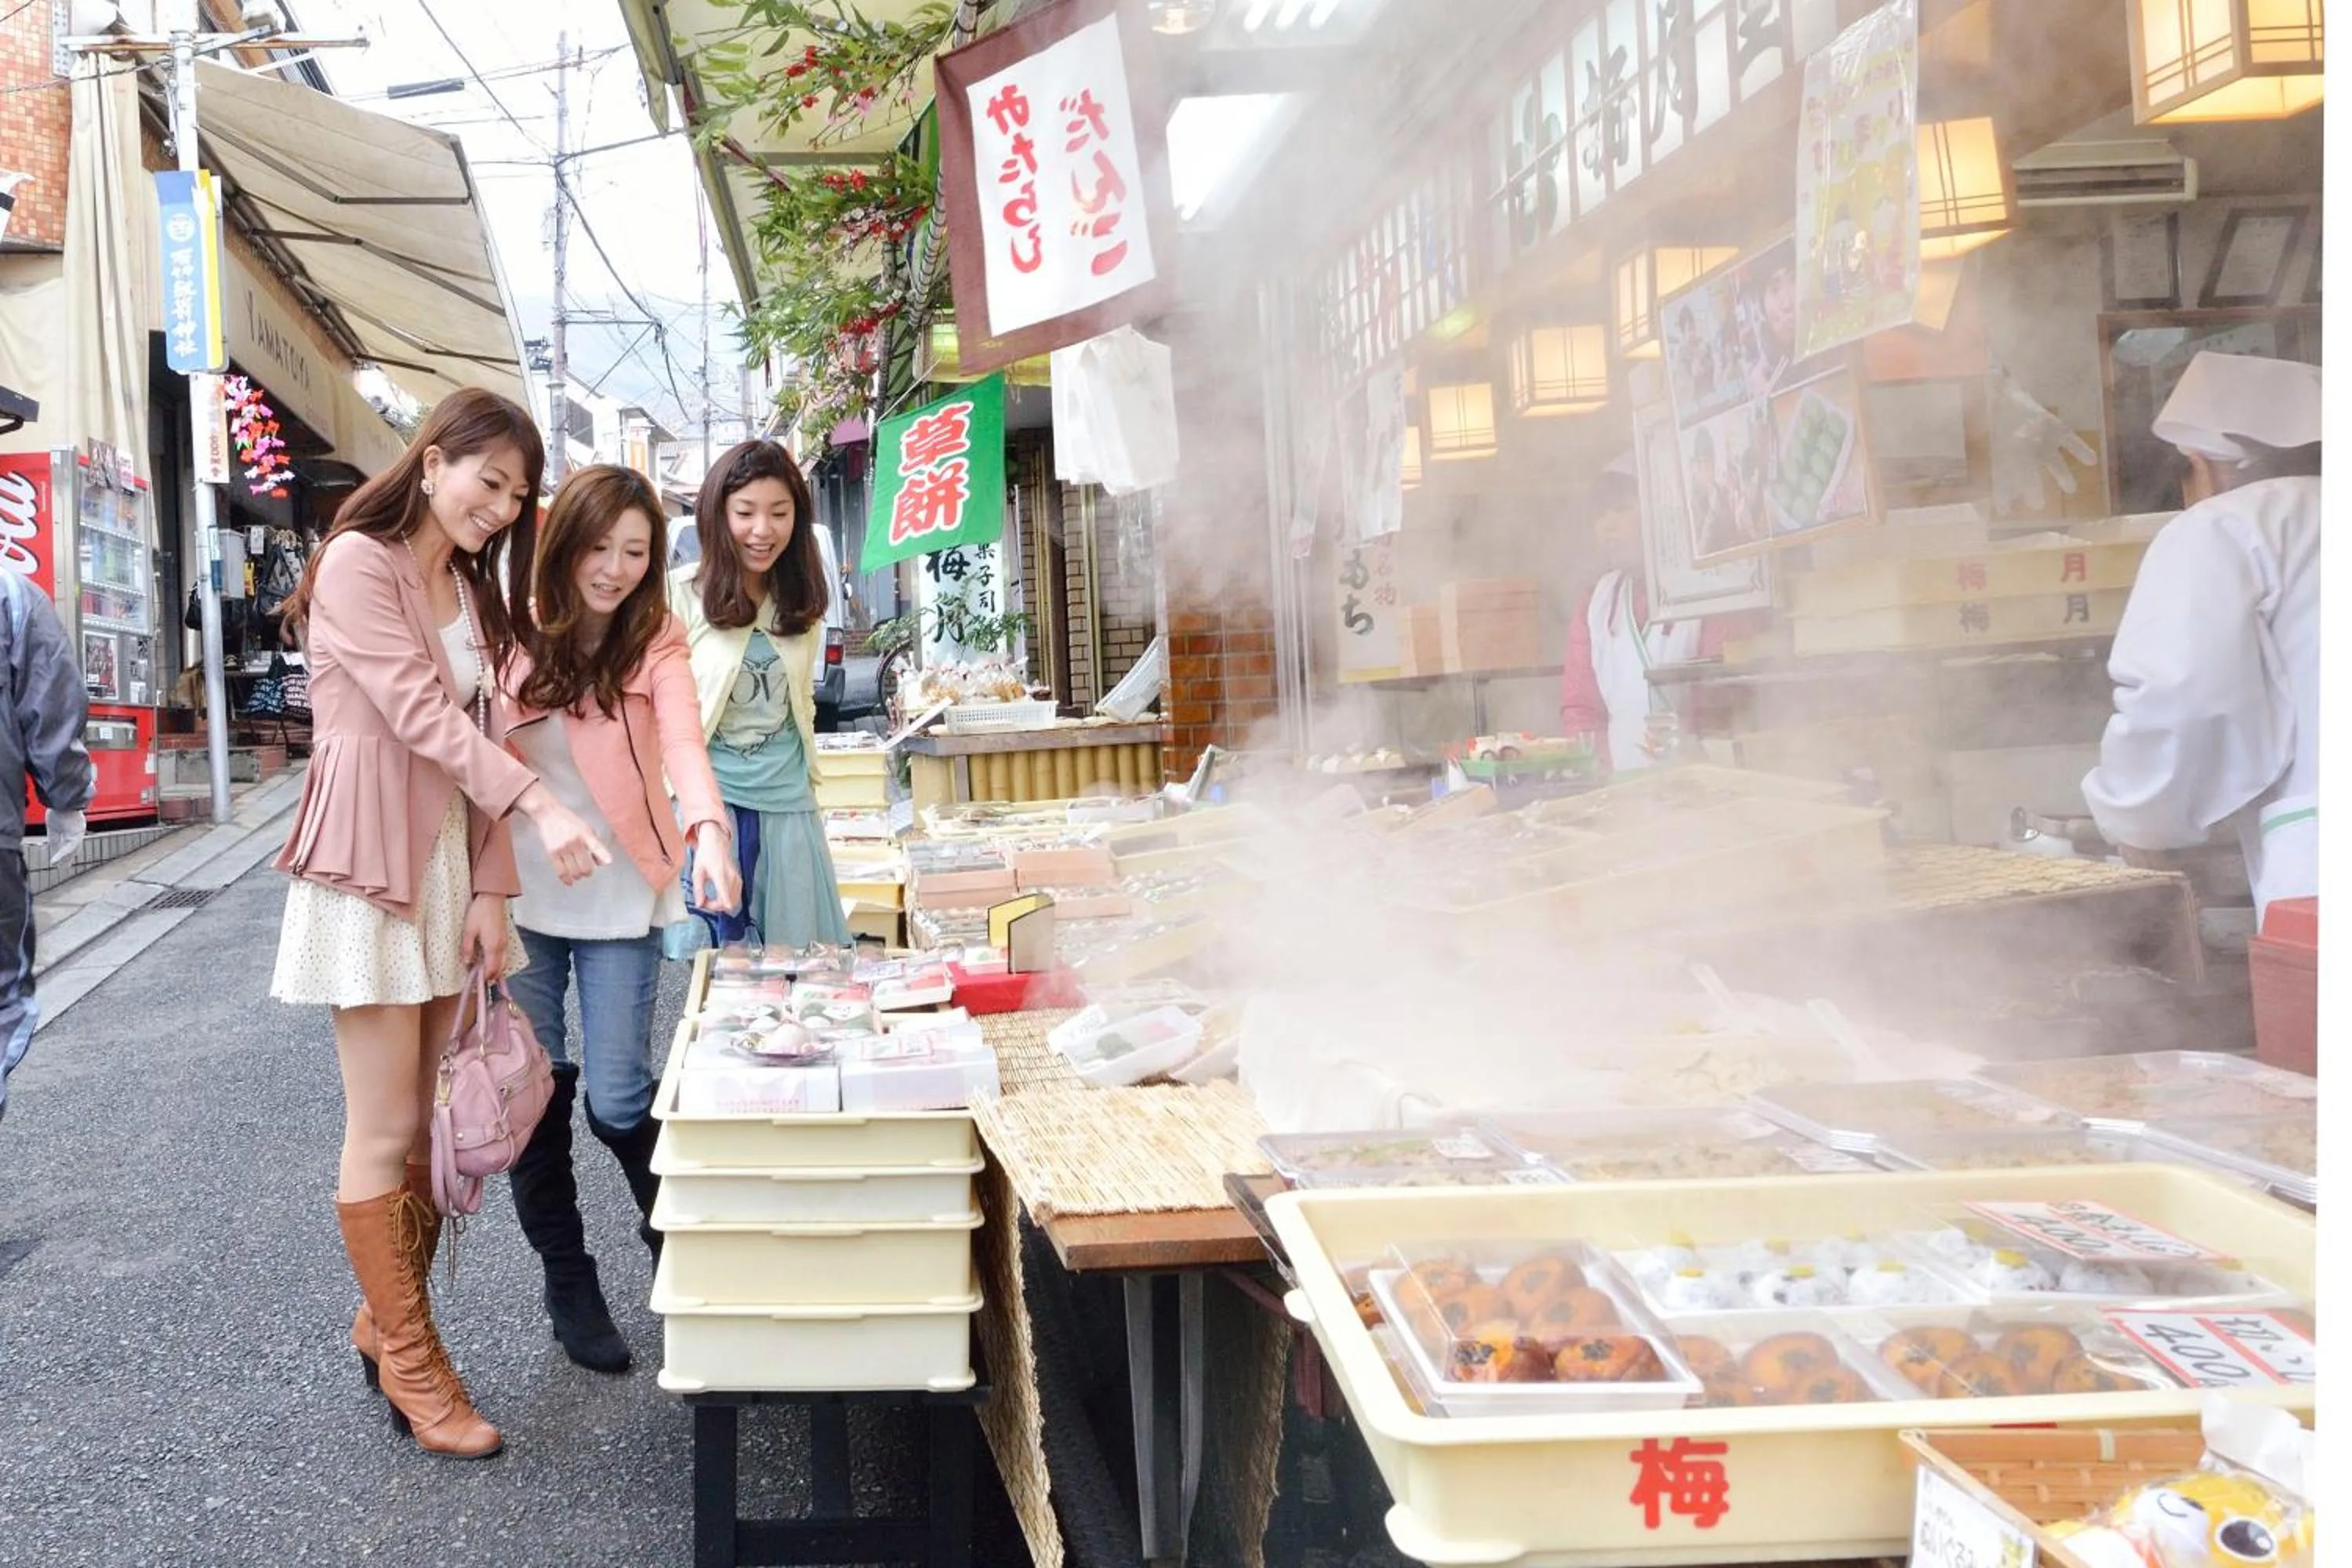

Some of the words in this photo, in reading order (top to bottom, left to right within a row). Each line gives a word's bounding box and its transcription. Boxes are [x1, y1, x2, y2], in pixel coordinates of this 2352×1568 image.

[891, 402, 971, 543] 草餅
[2060, 553, 2085, 583] 月
[2063, 593, 2089, 624] 月
[1629, 1436, 1730, 1530] 梅
